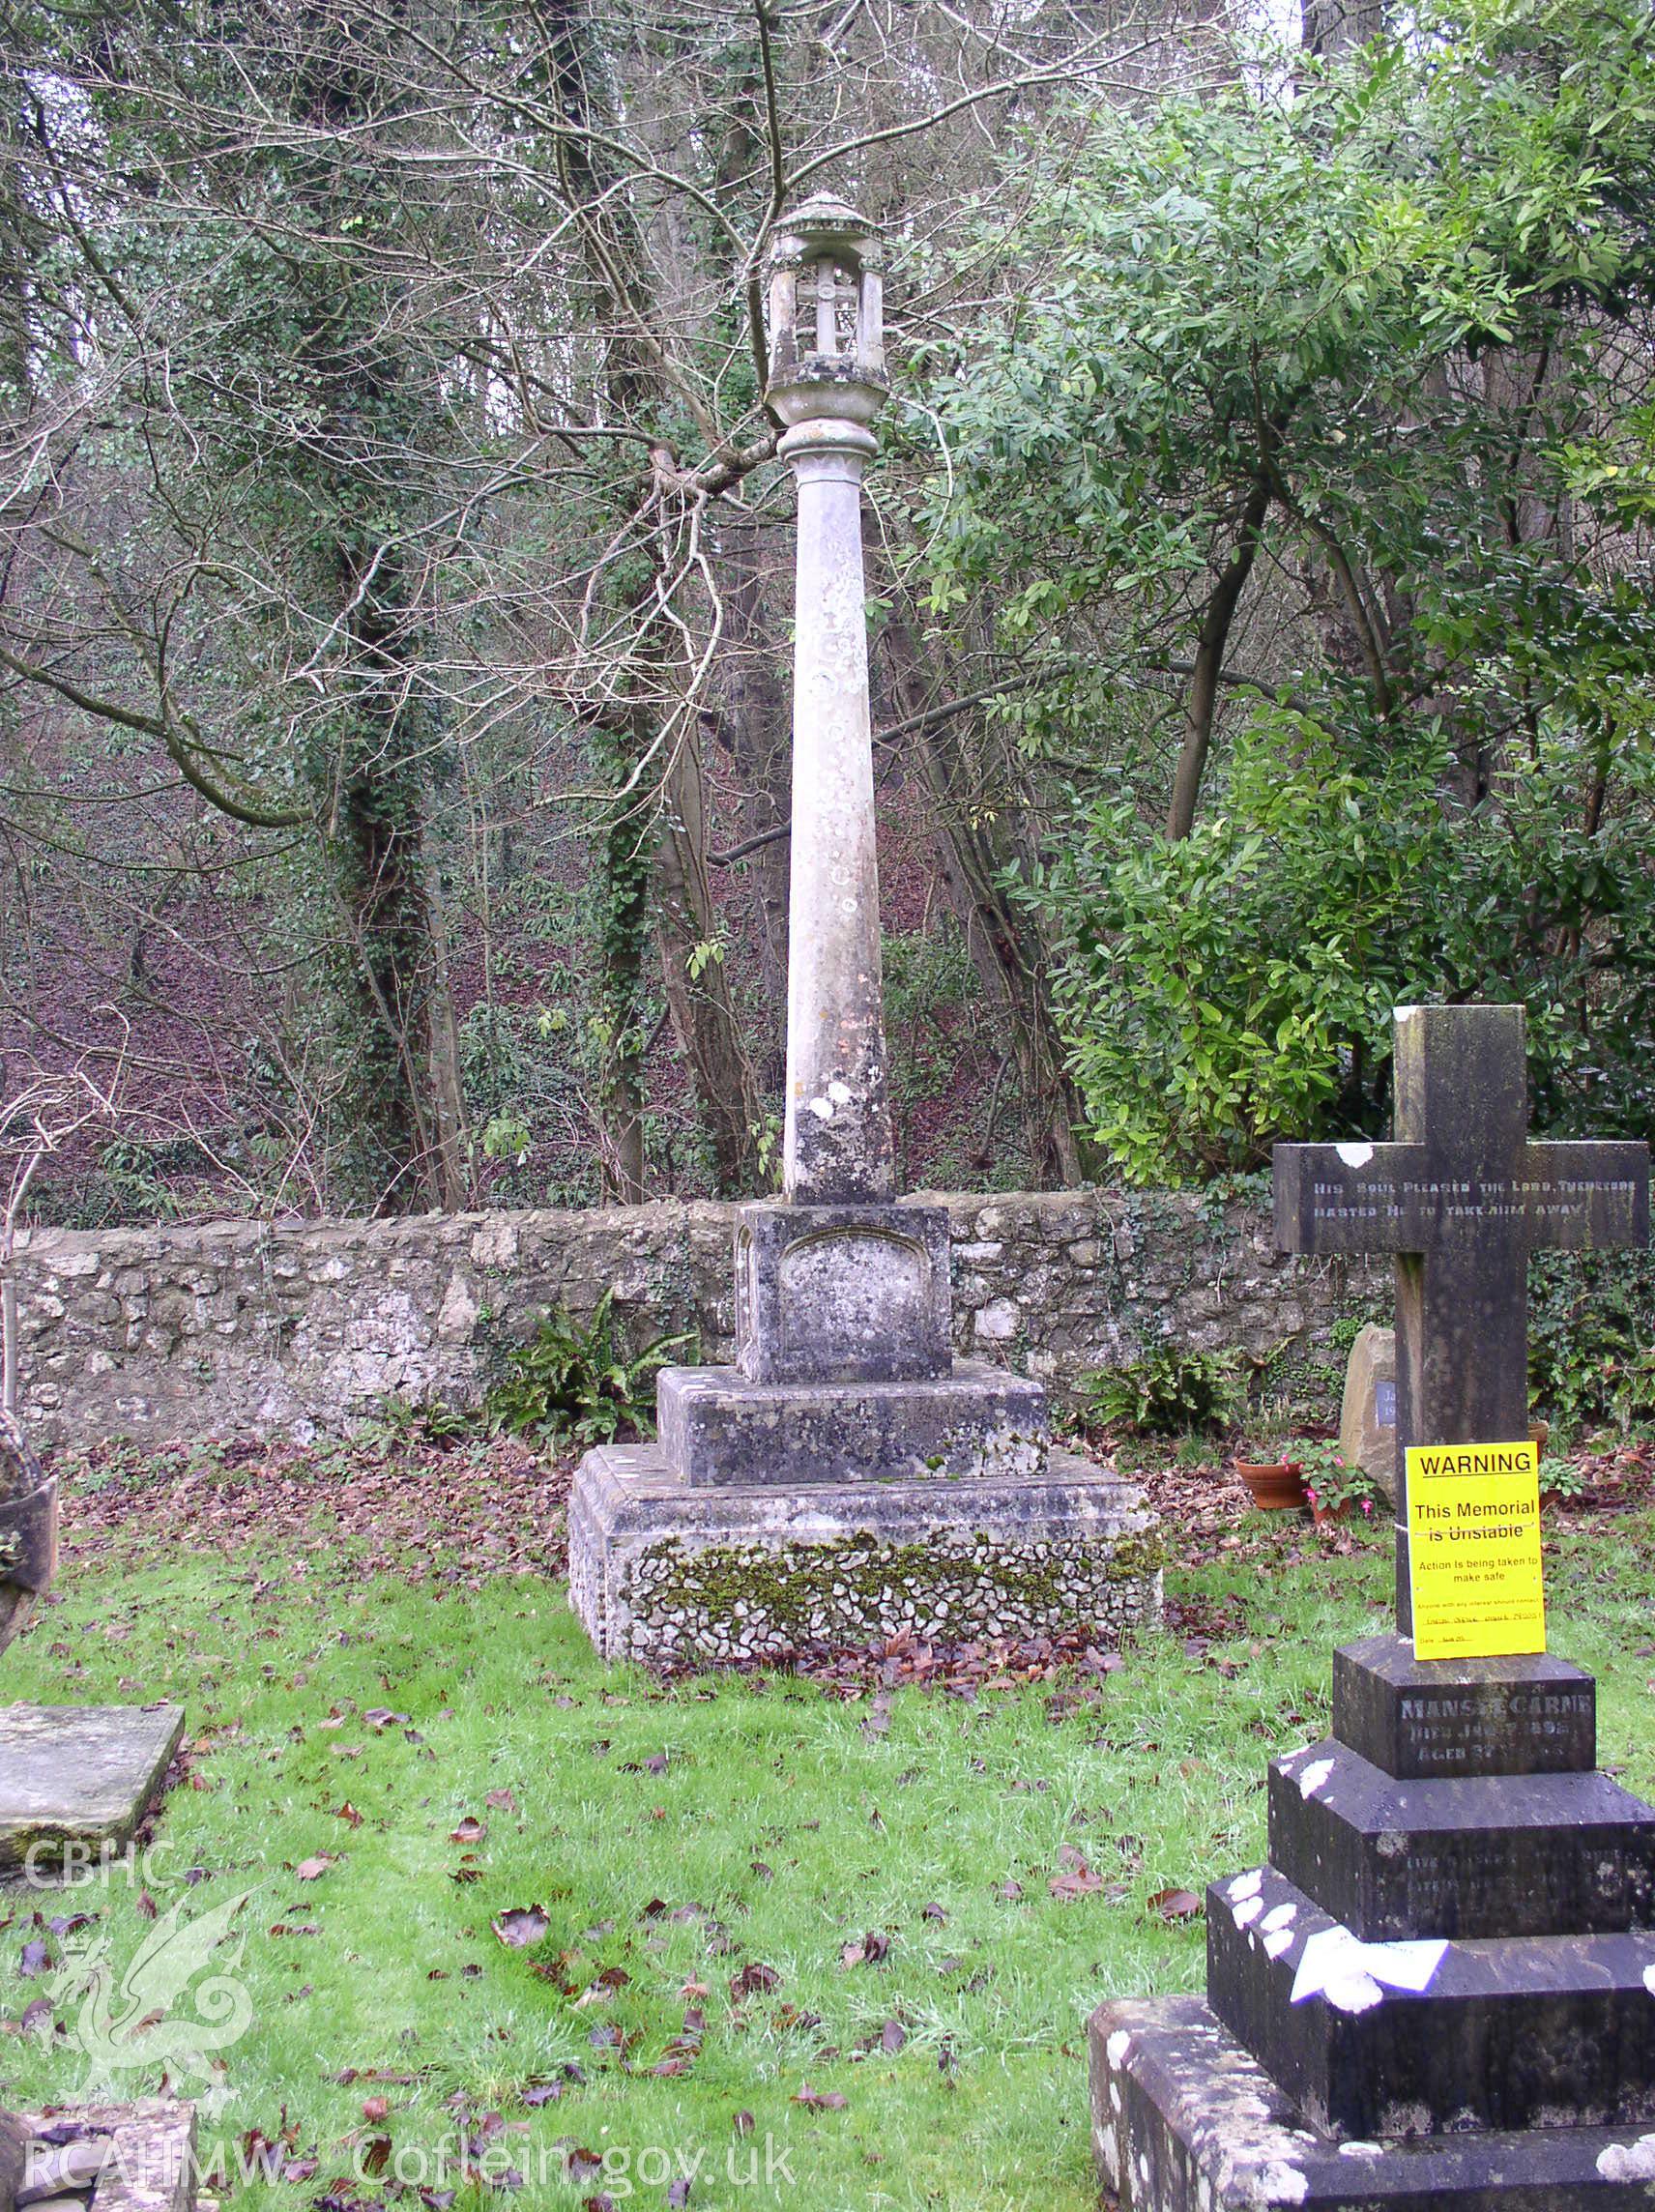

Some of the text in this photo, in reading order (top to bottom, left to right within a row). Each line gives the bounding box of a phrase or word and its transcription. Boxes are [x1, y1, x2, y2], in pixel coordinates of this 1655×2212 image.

[1315, 1182, 1344, 1195] HIS
[1356, 1181, 1396, 1193] SOUL
[1403, 1179, 1470, 1193] PLEASED
[1420, 1452, 1530, 1474] WARNING
[1415, 1499, 1535, 1520] This Memorial
[1429, 1524, 1524, 1541] is Unstable
[1419, 1556, 1538, 1570] Action is being taken to
[1453, 1571, 1505, 1583] make safe
